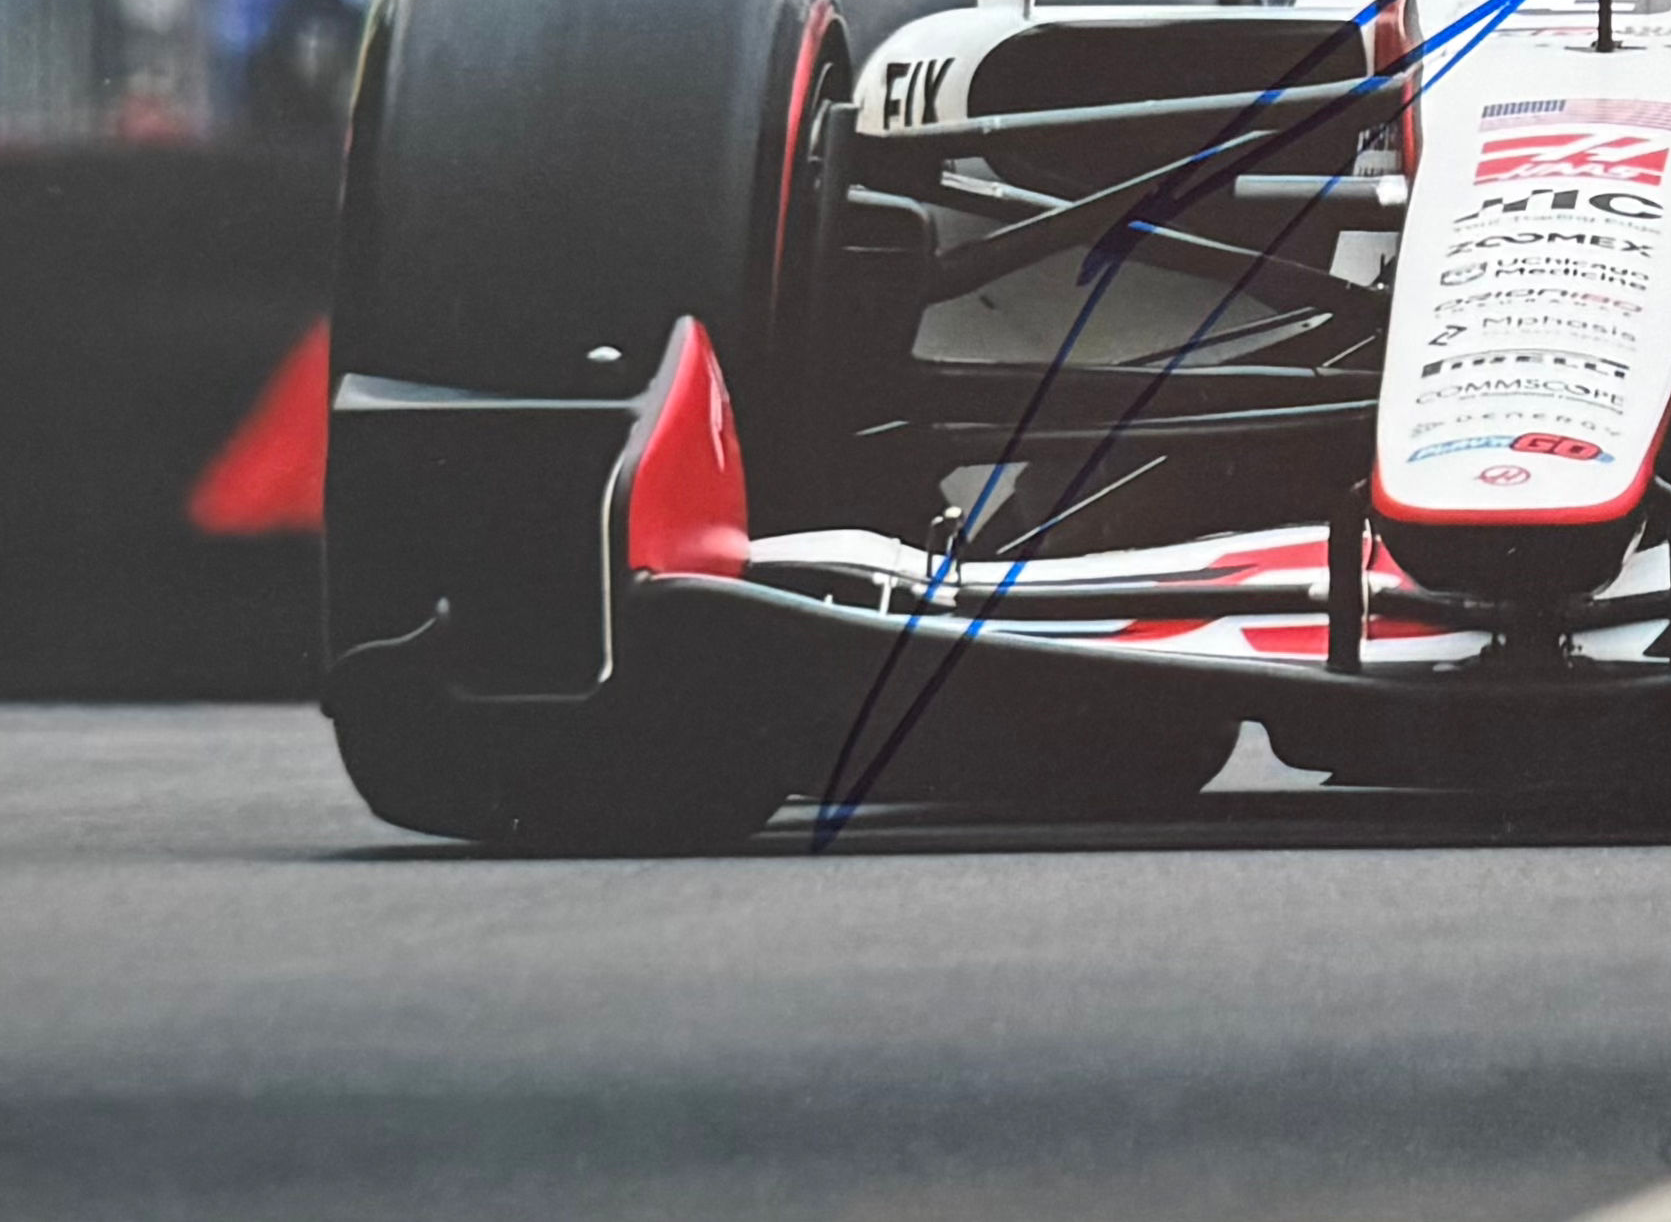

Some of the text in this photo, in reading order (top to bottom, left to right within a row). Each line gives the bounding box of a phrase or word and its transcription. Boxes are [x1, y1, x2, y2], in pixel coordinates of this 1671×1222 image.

[1446, 232, 1654, 258] ZOOMEX
[1483, 315, 1636, 343] Mphasis
[1416, 377, 1624, 407] COMMSCOPE
